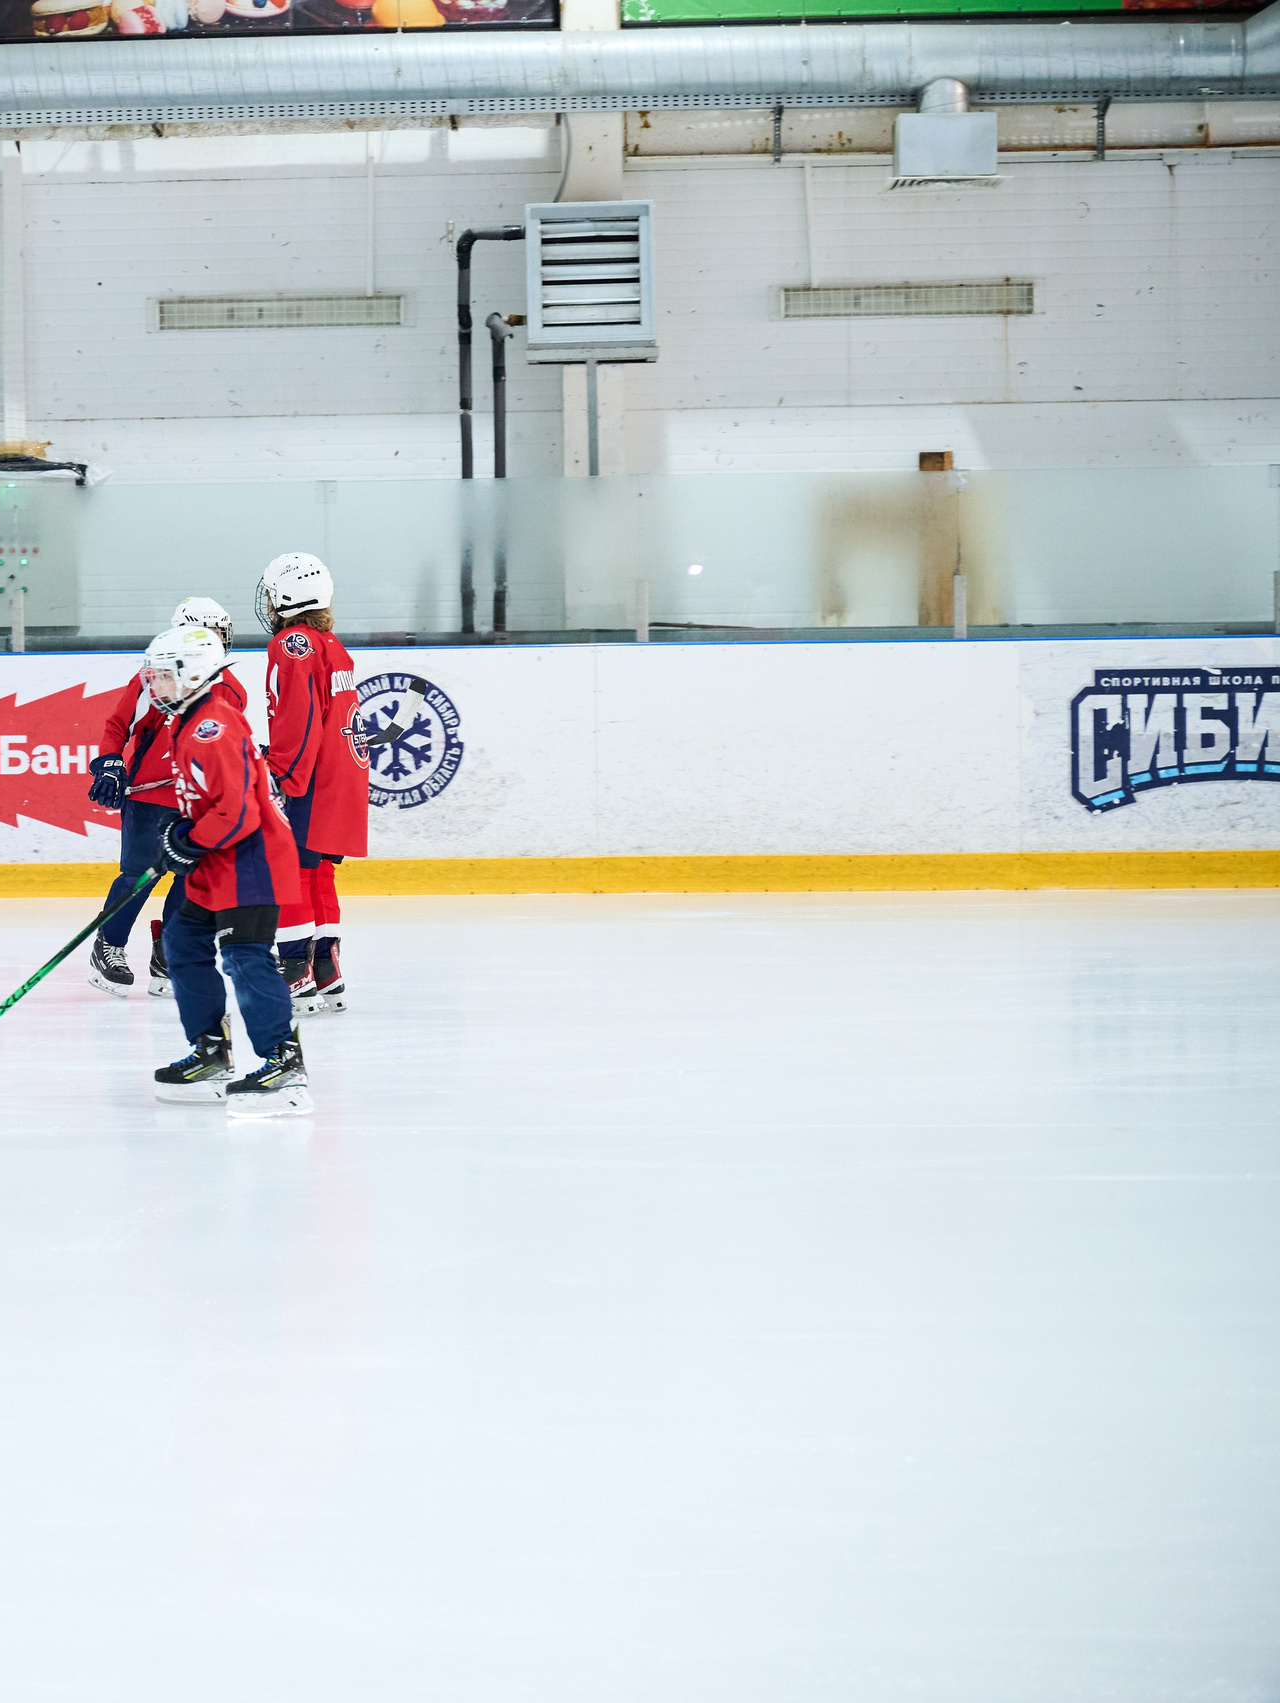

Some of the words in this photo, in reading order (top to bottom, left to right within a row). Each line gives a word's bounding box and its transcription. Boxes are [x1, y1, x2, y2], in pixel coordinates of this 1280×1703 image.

[1100, 676, 1201, 687] СПОРТИВНАЯ
[1208, 675, 1263, 686] ШКОЛА
[426, 689, 460, 736] СИБИРЬ
[422, 747, 462, 799] ОБЛАСТЬ
